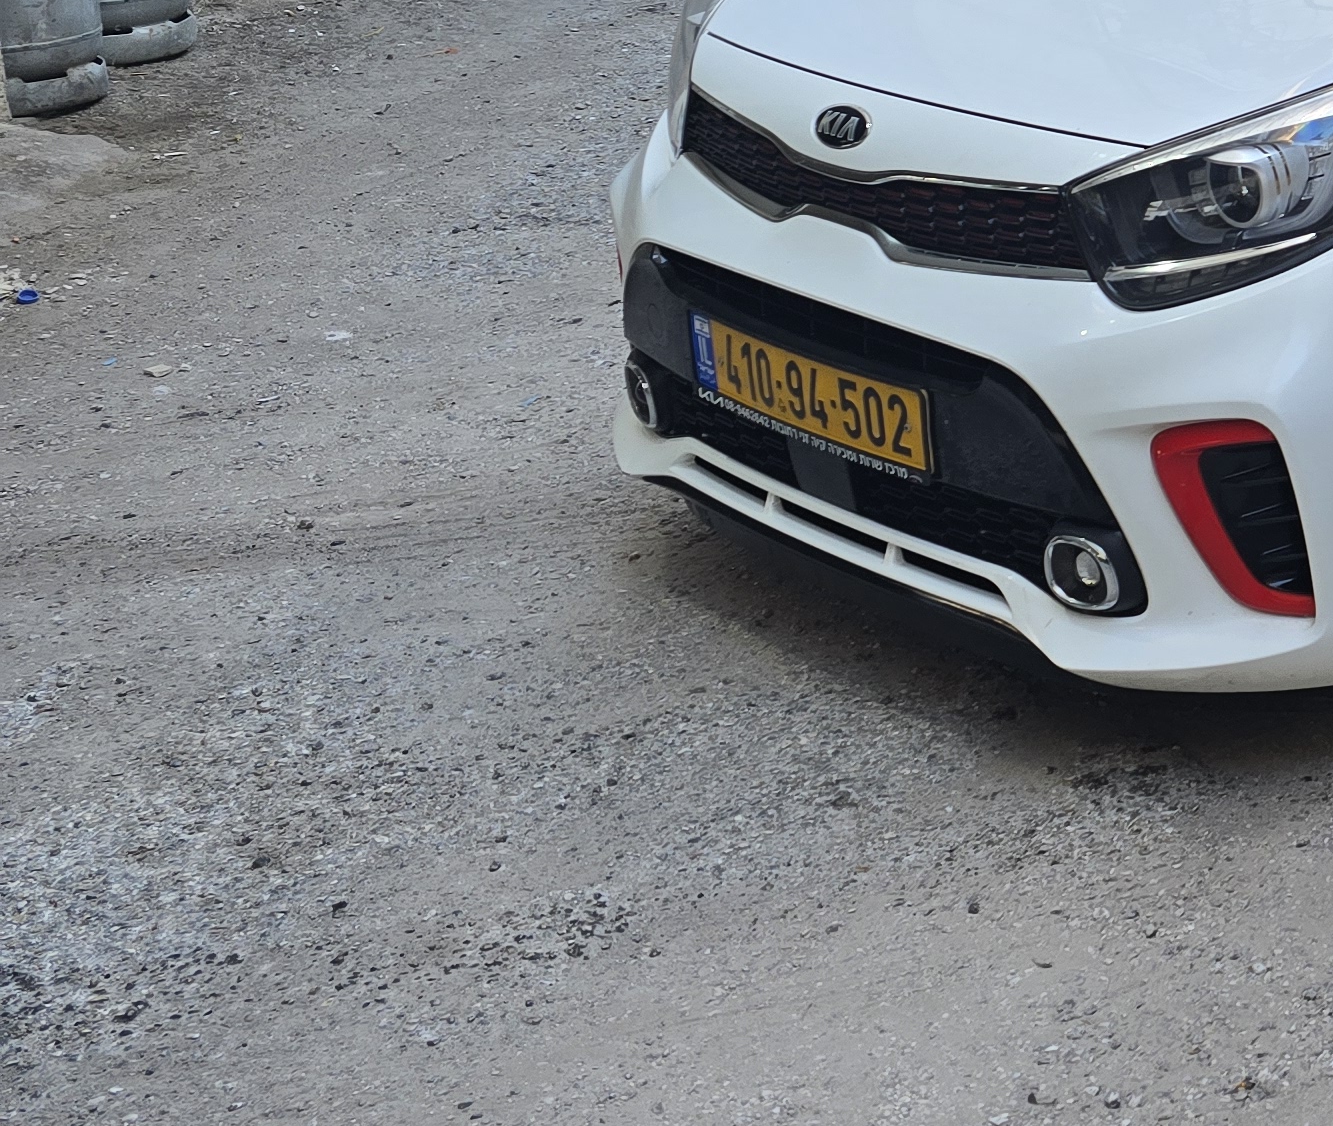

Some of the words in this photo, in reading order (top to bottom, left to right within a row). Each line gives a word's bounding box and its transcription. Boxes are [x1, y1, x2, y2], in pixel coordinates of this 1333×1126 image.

[817, 110, 860, 141] KIA
[697, 334, 713, 366] IL
[697, 386, 724, 408] KIA
[810, 435, 827, 451] קיה
[884, 462, 908, 480] מרכז
